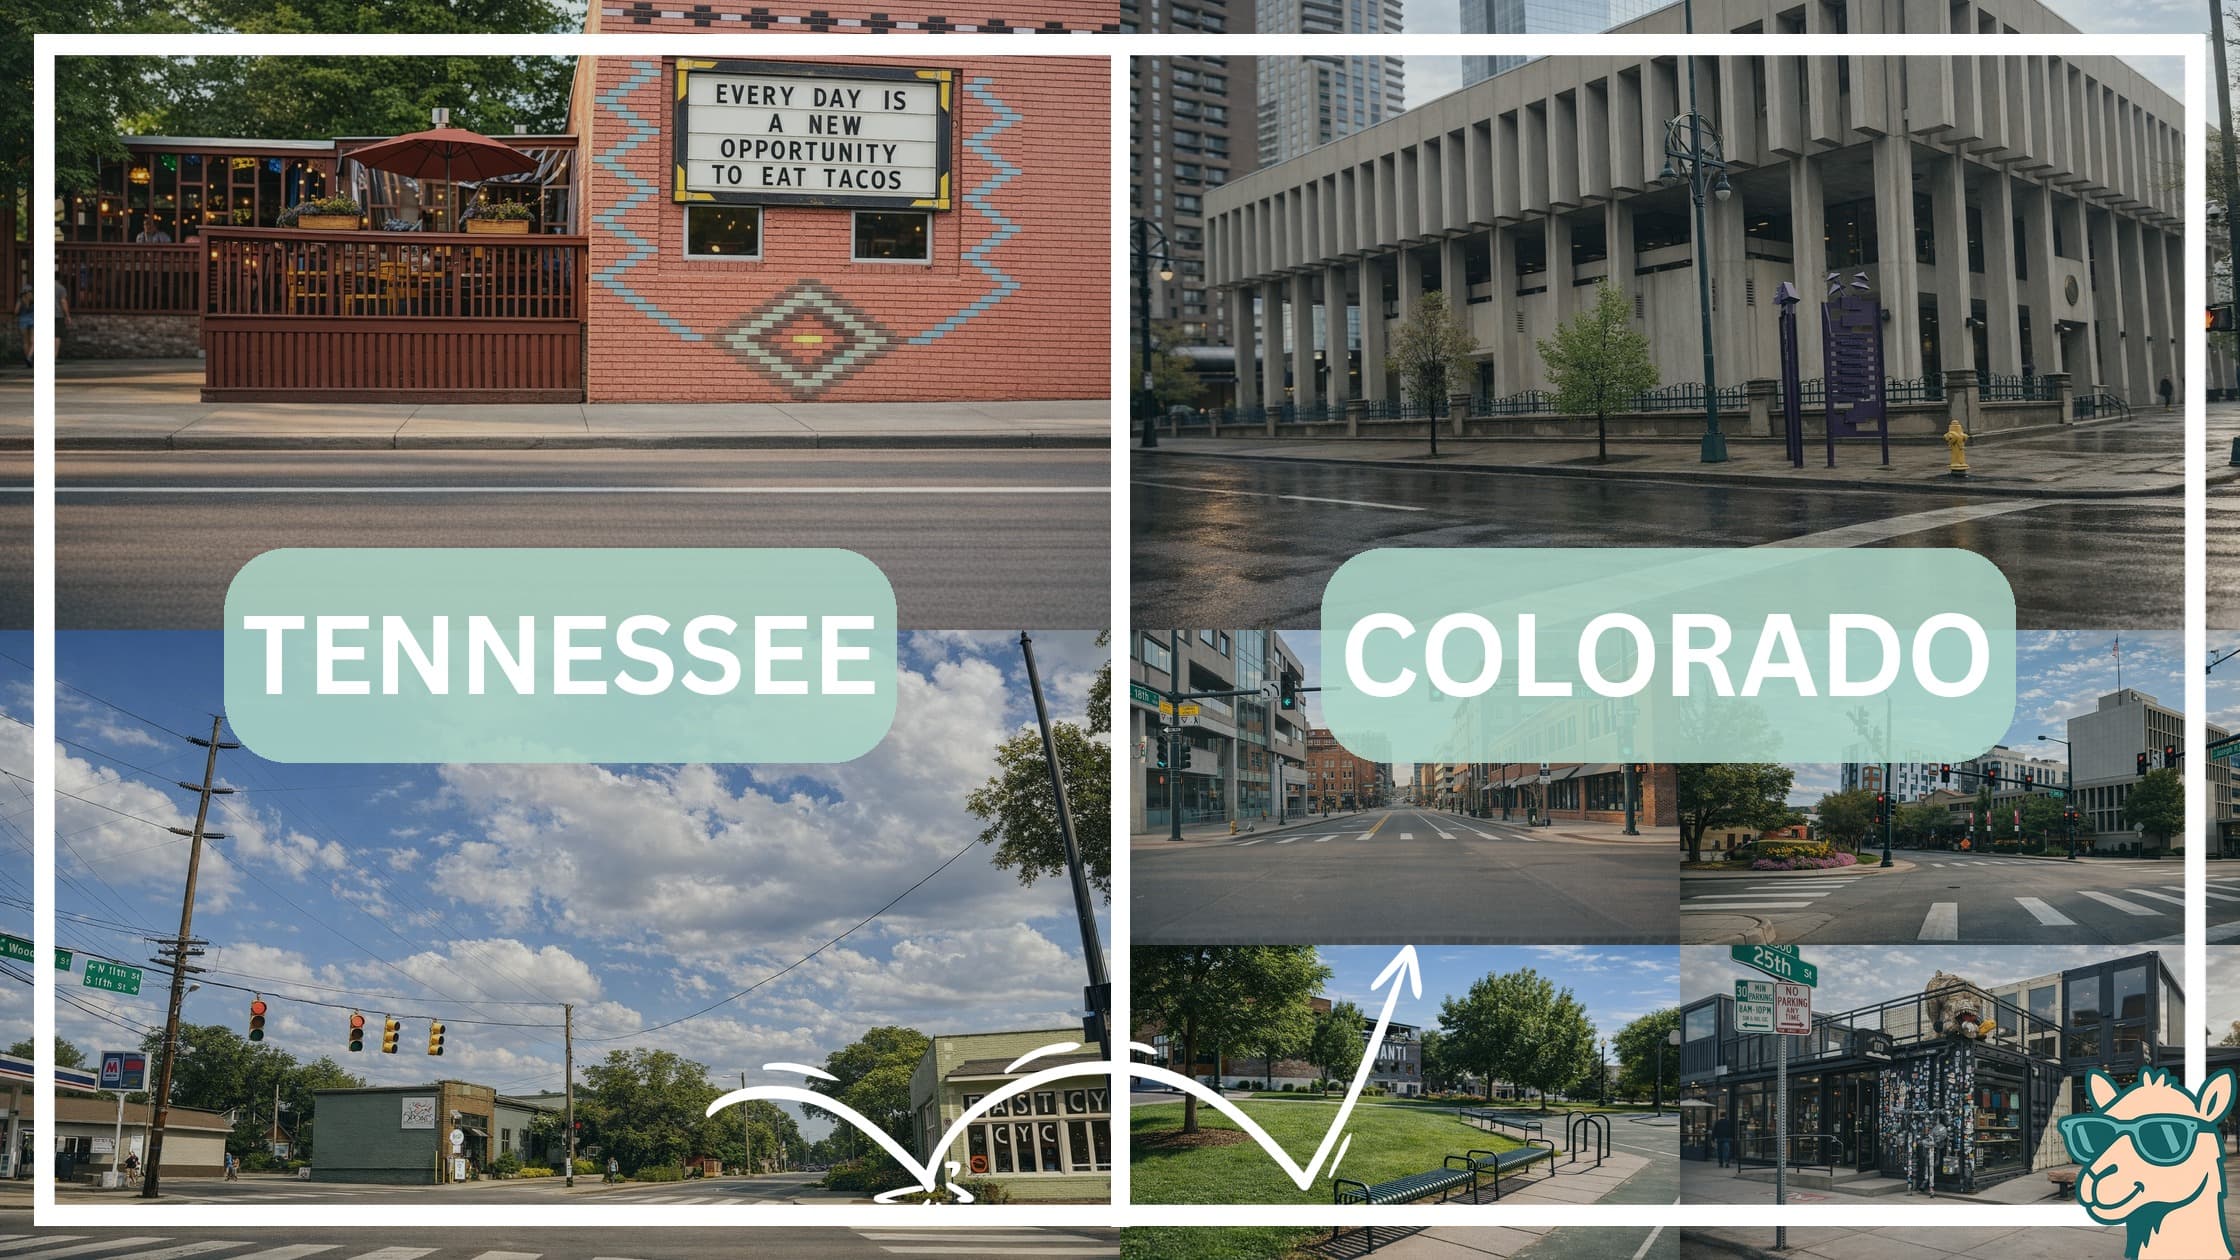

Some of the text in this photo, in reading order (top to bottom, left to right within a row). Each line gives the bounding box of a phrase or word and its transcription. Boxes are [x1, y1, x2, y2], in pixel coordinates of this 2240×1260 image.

[716, 83, 906, 110] EVERY DAY IS
[768, 113, 861, 135] A NEW
[720, 139, 897, 163] OPPORTUNITY
[712, 165, 901, 190] TO EAT TACOS
[1753, 946, 1812, 979] 25th St
[98, 964, 105, 973] N
[108, 967, 126, 978] 11th
[86, 976, 92, 984] S
[95, 977, 112, 988] 11th
[1754, 984, 1767, 993] MIN
[1736, 985, 1748, 998] 30
[1748, 992, 1773, 1002] PARKING
[1785, 986, 1799, 997] NO
[1777, 996, 1808, 1008] PARKING
[1376, 1044, 1407, 1061] ANTI
